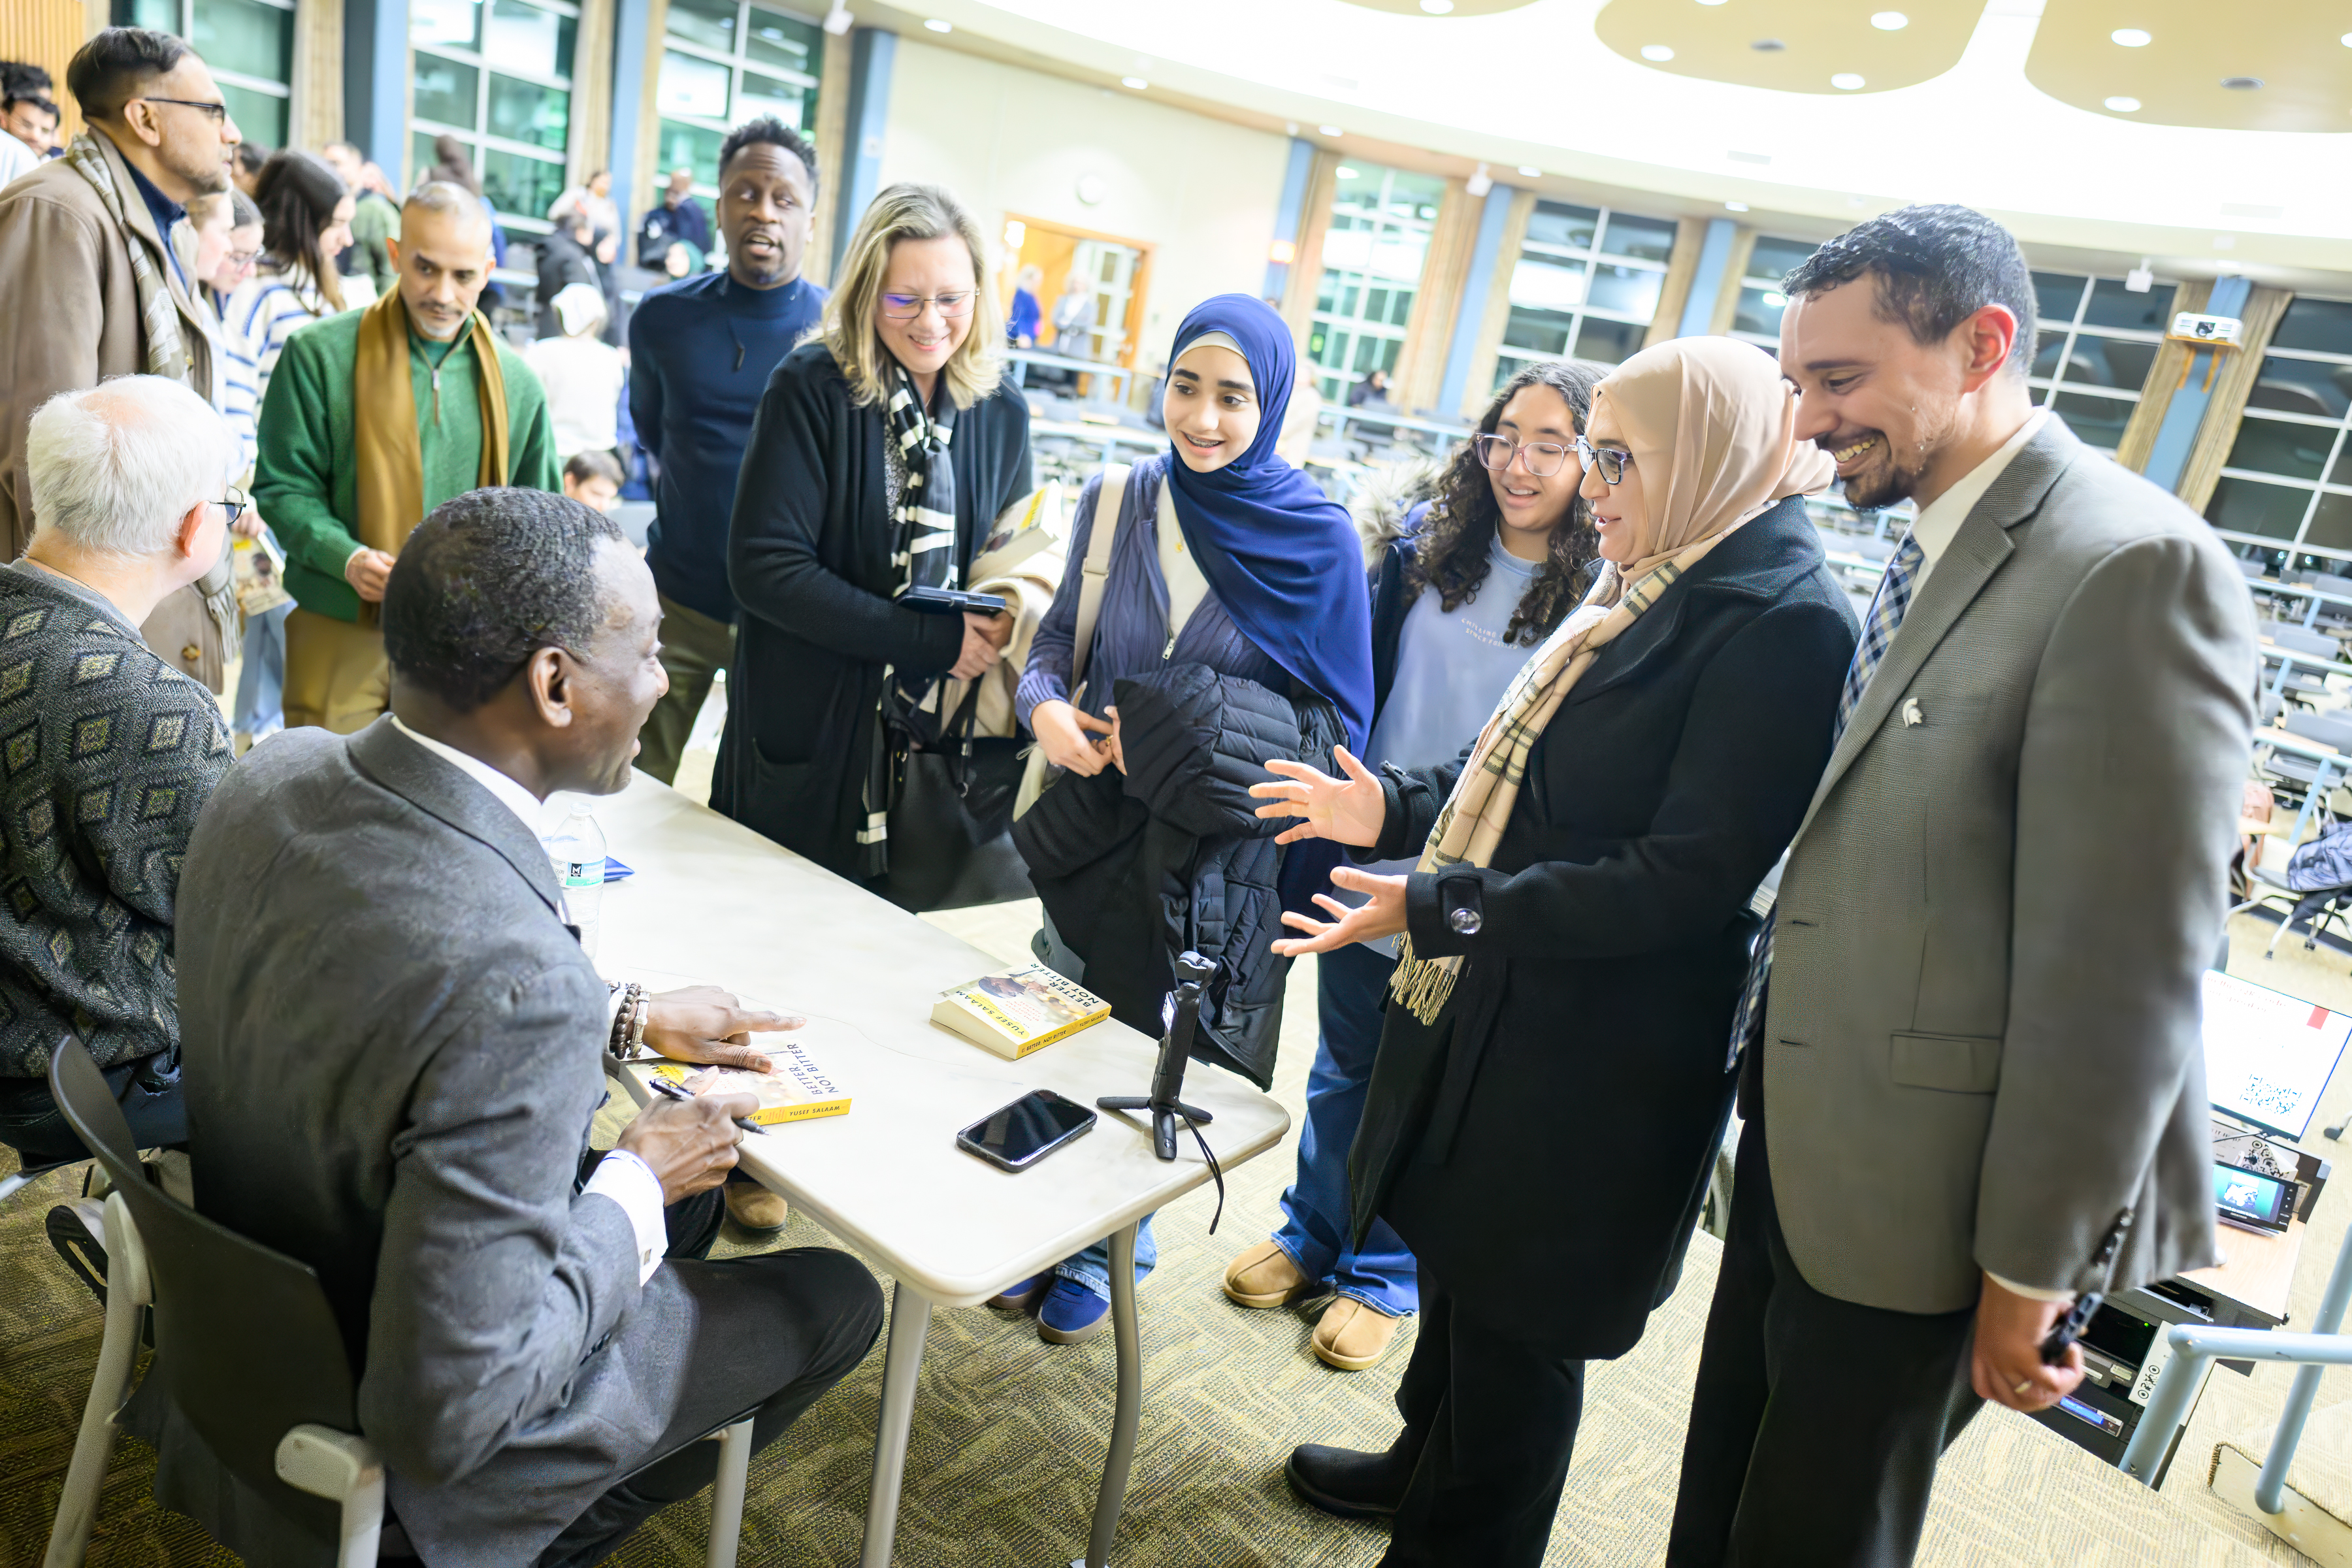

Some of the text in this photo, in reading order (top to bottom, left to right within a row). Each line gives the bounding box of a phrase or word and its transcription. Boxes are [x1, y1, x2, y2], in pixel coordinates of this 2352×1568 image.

[1031, 963, 1099, 1004] NOT BITTER
[1049, 979, 1091, 1007] BETTER,
[956, 990, 995, 1014] SALAAM
[996, 1016, 1024, 1035] YUSEF
[787, 1043, 839, 1094] NOT BITTER
[789, 1063, 823, 1095] BETTER,
[812, 1105, 840, 1114] SALAAM
